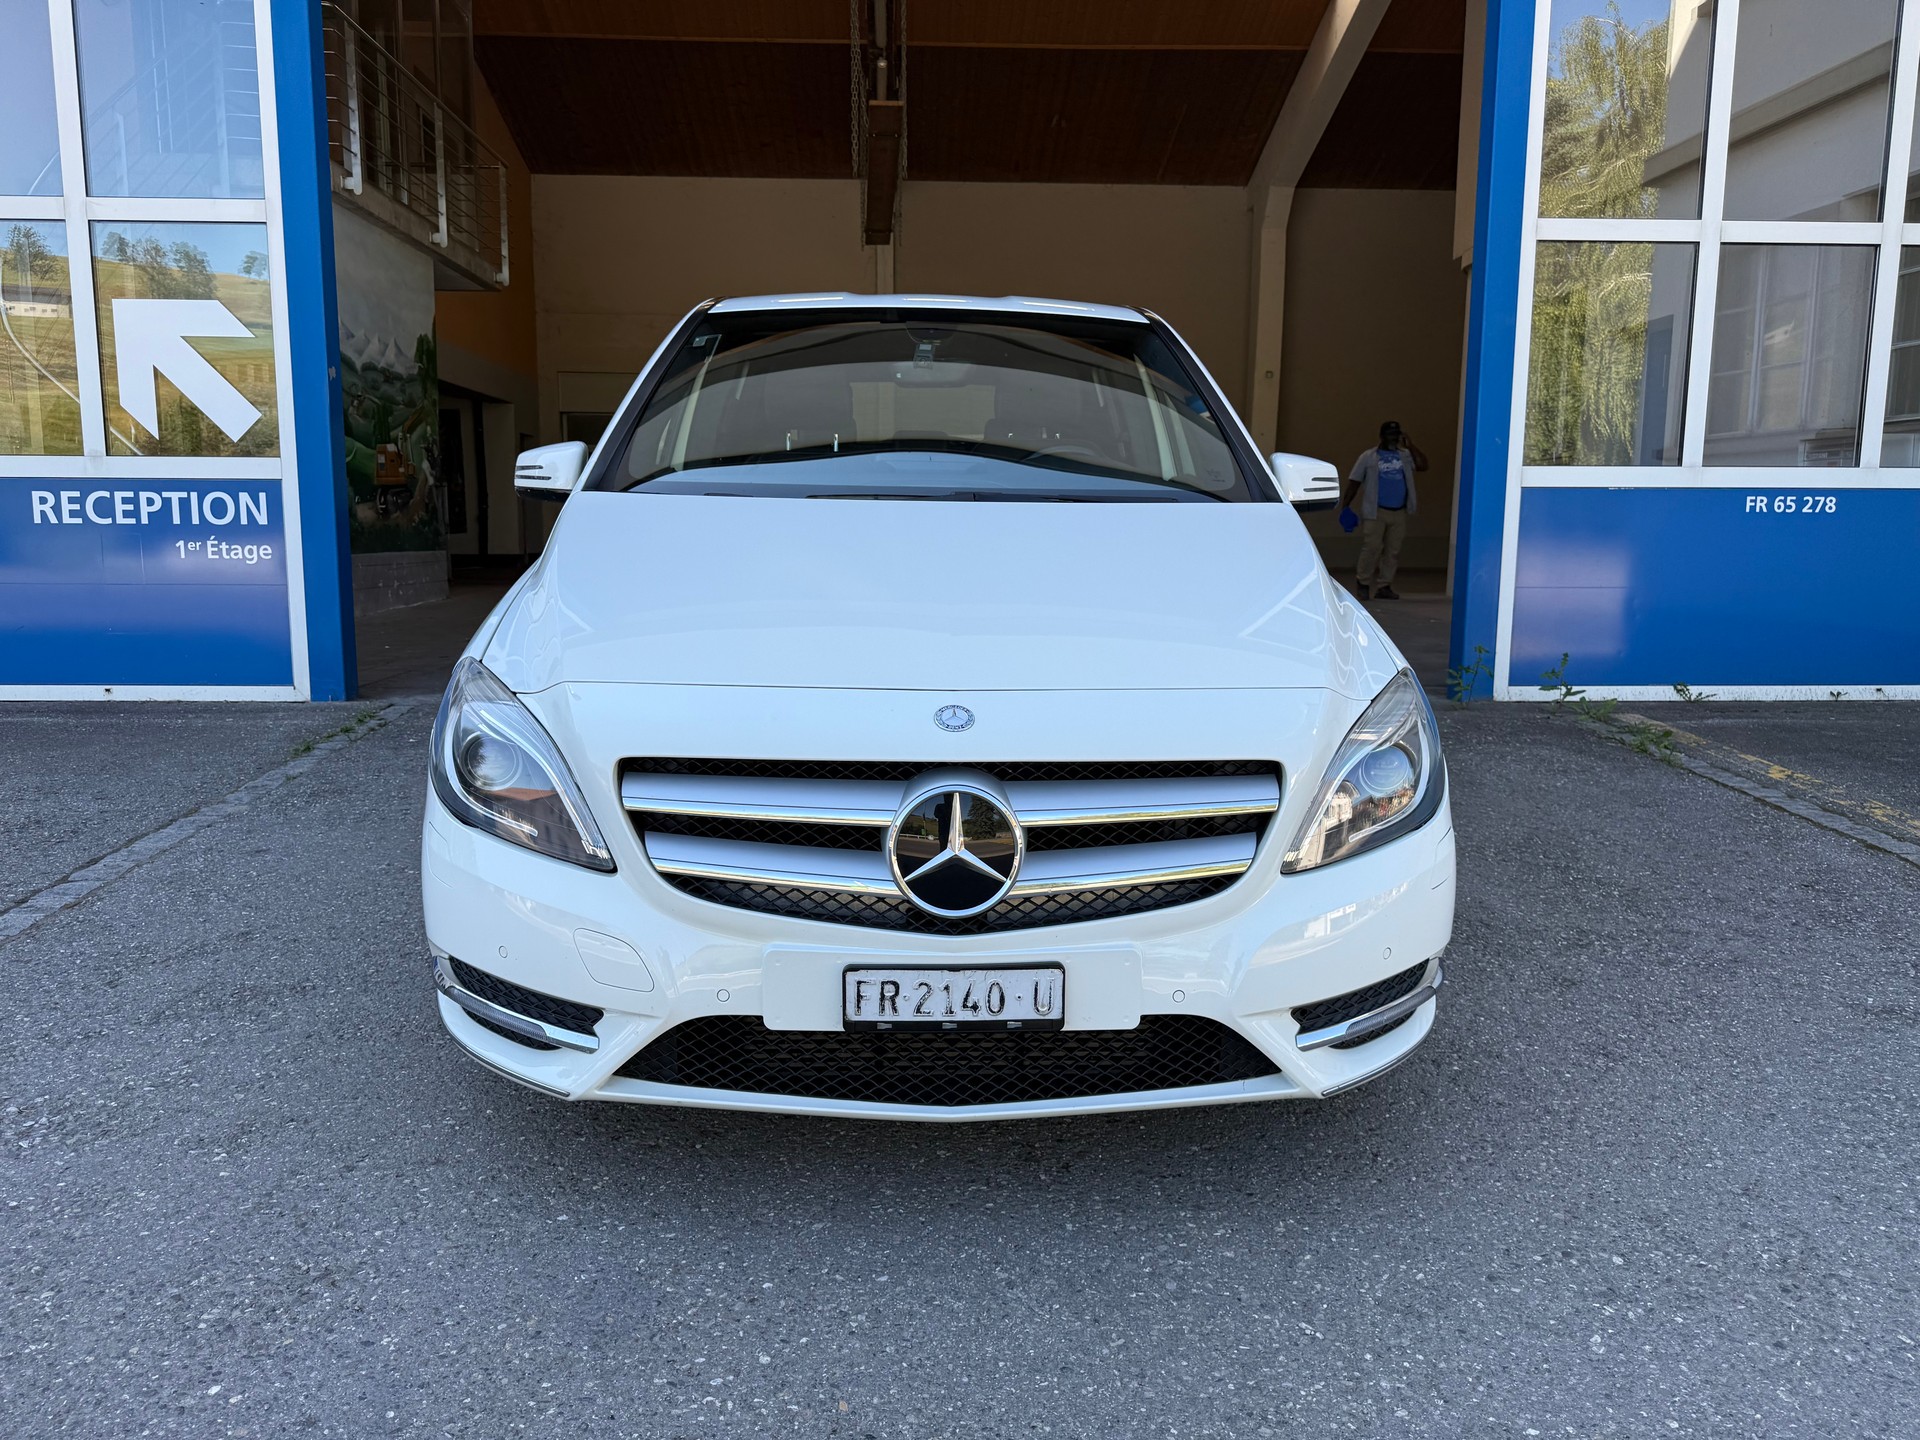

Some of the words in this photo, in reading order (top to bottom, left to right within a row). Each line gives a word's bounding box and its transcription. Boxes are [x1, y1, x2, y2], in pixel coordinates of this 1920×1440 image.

[31, 490, 268, 525] RECEPTION
[1745, 496, 1768, 513] FR
[1773, 496, 1797, 513] 65
[1801, 496, 1837, 513] 278
[175, 540, 202, 559] 1er
[206, 536, 273, 564] Étage
